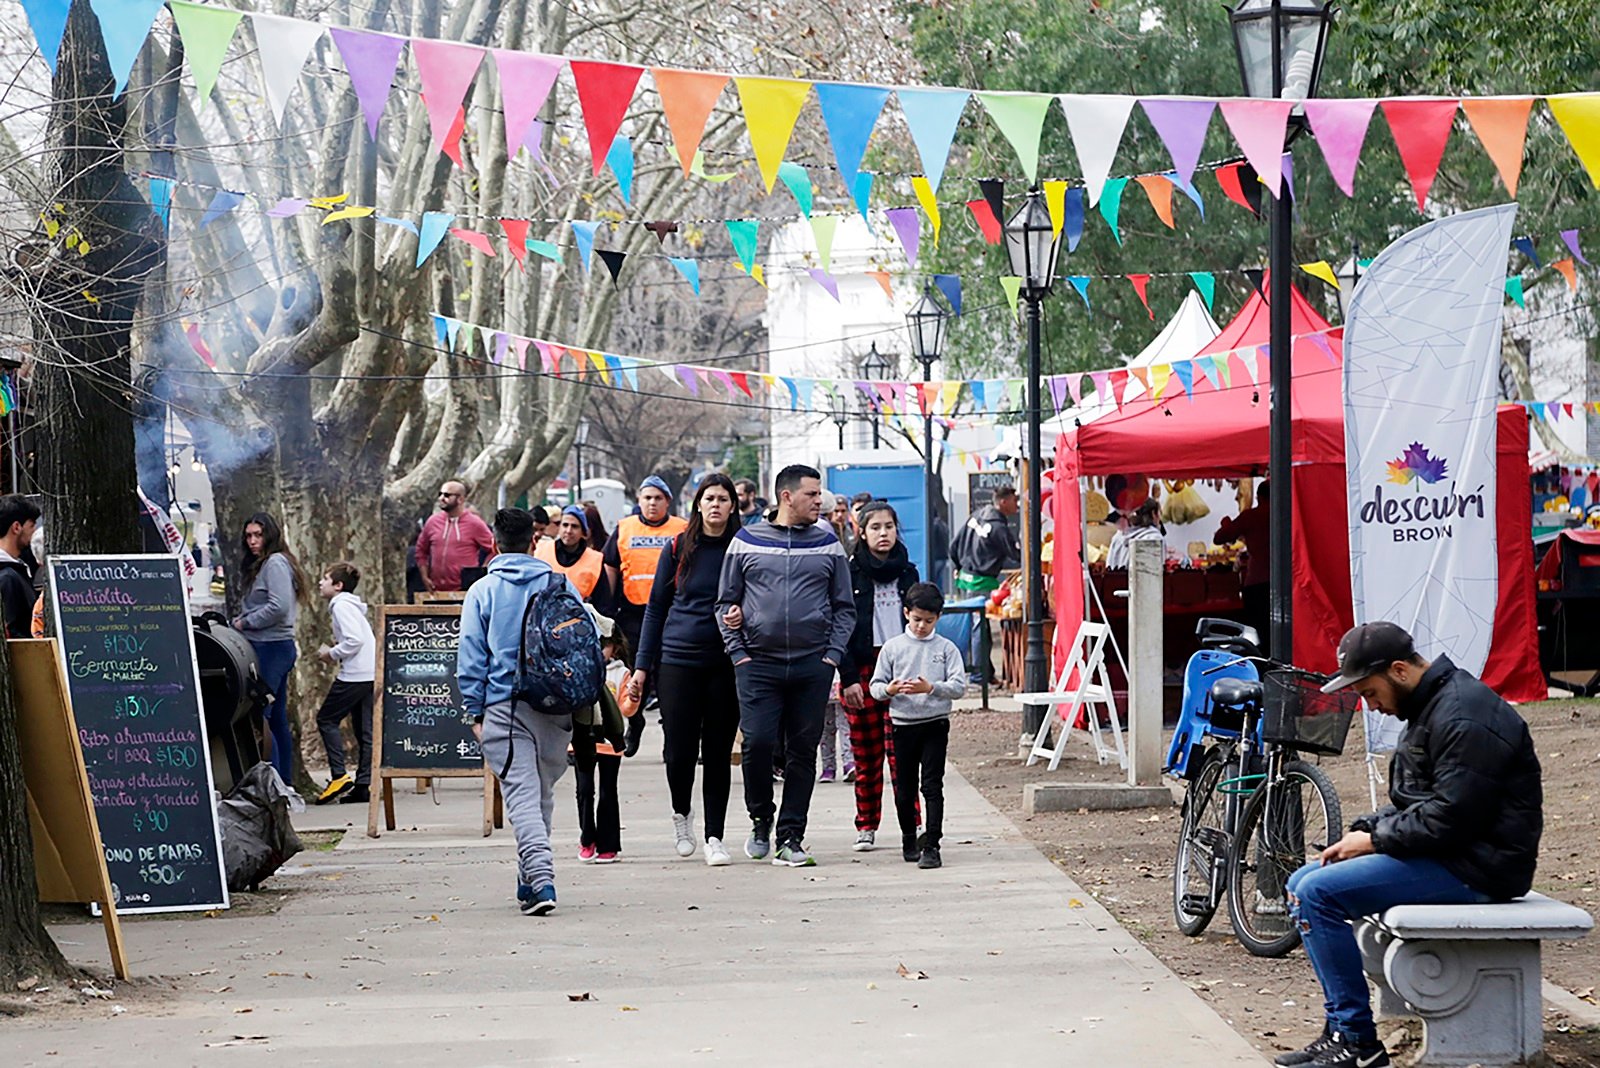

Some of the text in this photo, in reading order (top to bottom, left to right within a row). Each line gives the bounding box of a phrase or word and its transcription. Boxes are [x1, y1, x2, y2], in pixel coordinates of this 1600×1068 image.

[1360, 481, 1485, 524] descubrí
[1393, 525, 1453, 542] BROWN
[60, 587, 137, 605] Bondiolita
[69, 649, 158, 678] Ternerita
[92, 791, 137, 807] anceta
[101, 843, 203, 862] ONO DE PAPAS
